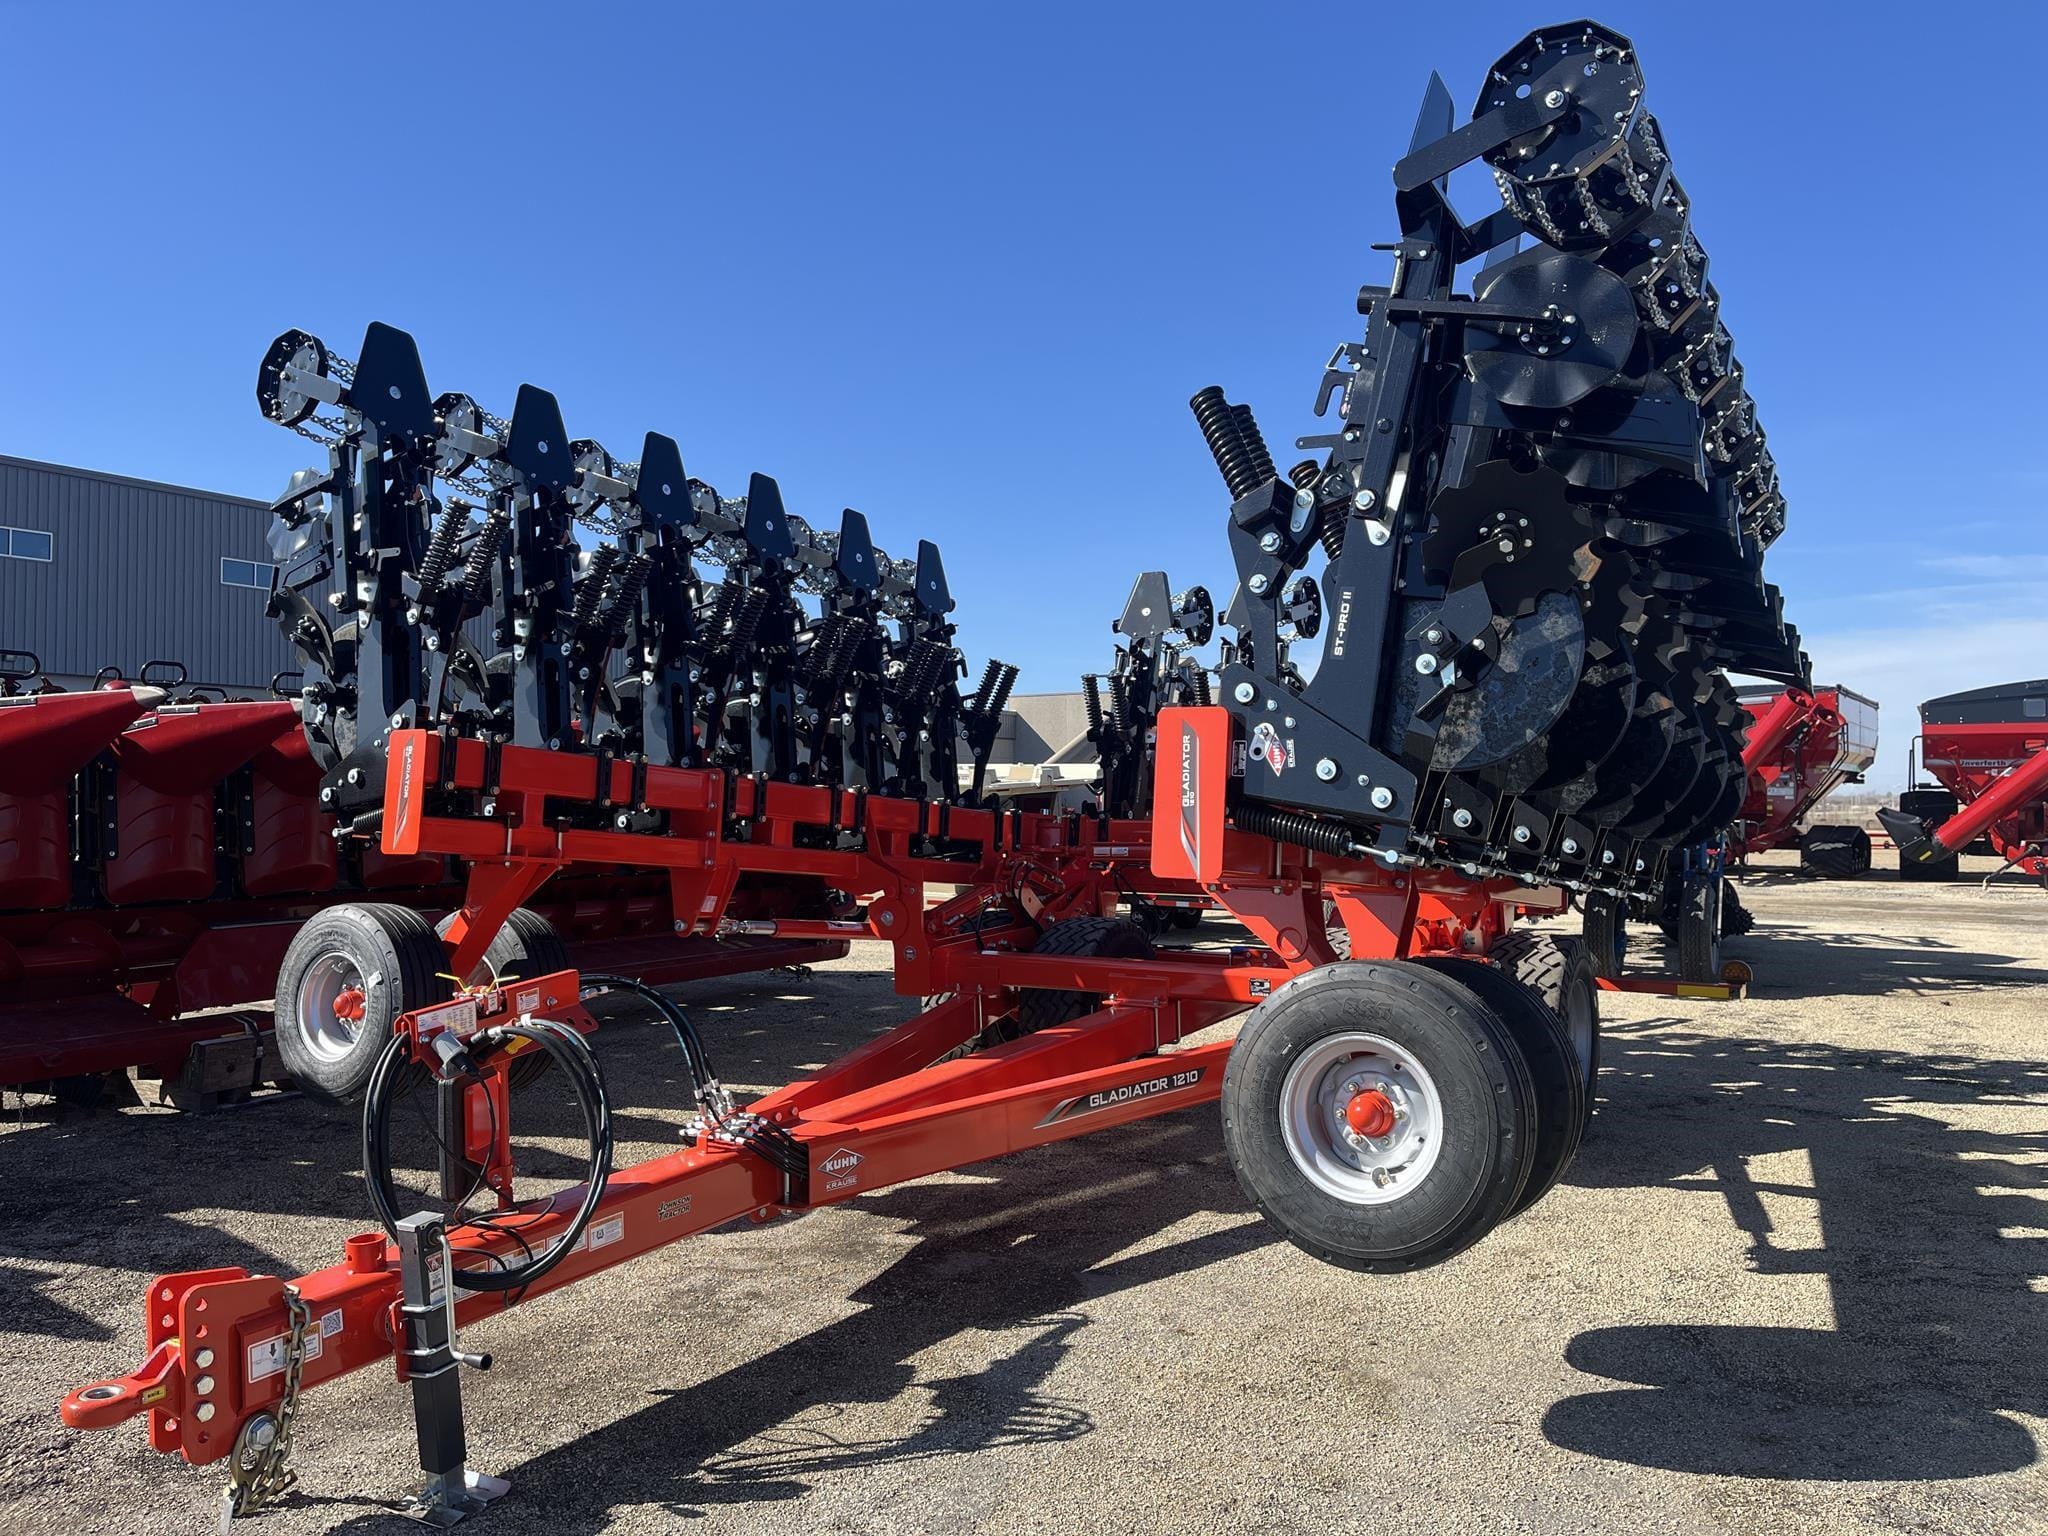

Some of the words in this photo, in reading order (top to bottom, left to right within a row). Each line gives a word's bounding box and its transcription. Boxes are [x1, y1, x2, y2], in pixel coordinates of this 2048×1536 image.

[1334, 603, 1350, 656] ST-PRO
[1182, 735, 1191, 807] GLADIATOR
[1089, 1078, 1168, 1107] GLADIATOR
[1172, 1070, 1198, 1087] 1210
[826, 1155, 857, 1172] KUHN
[826, 1177, 857, 1189] KRAUSE
[657, 1195, 692, 1212] JOHNSON
[658, 1205, 690, 1221] TRACTOR
